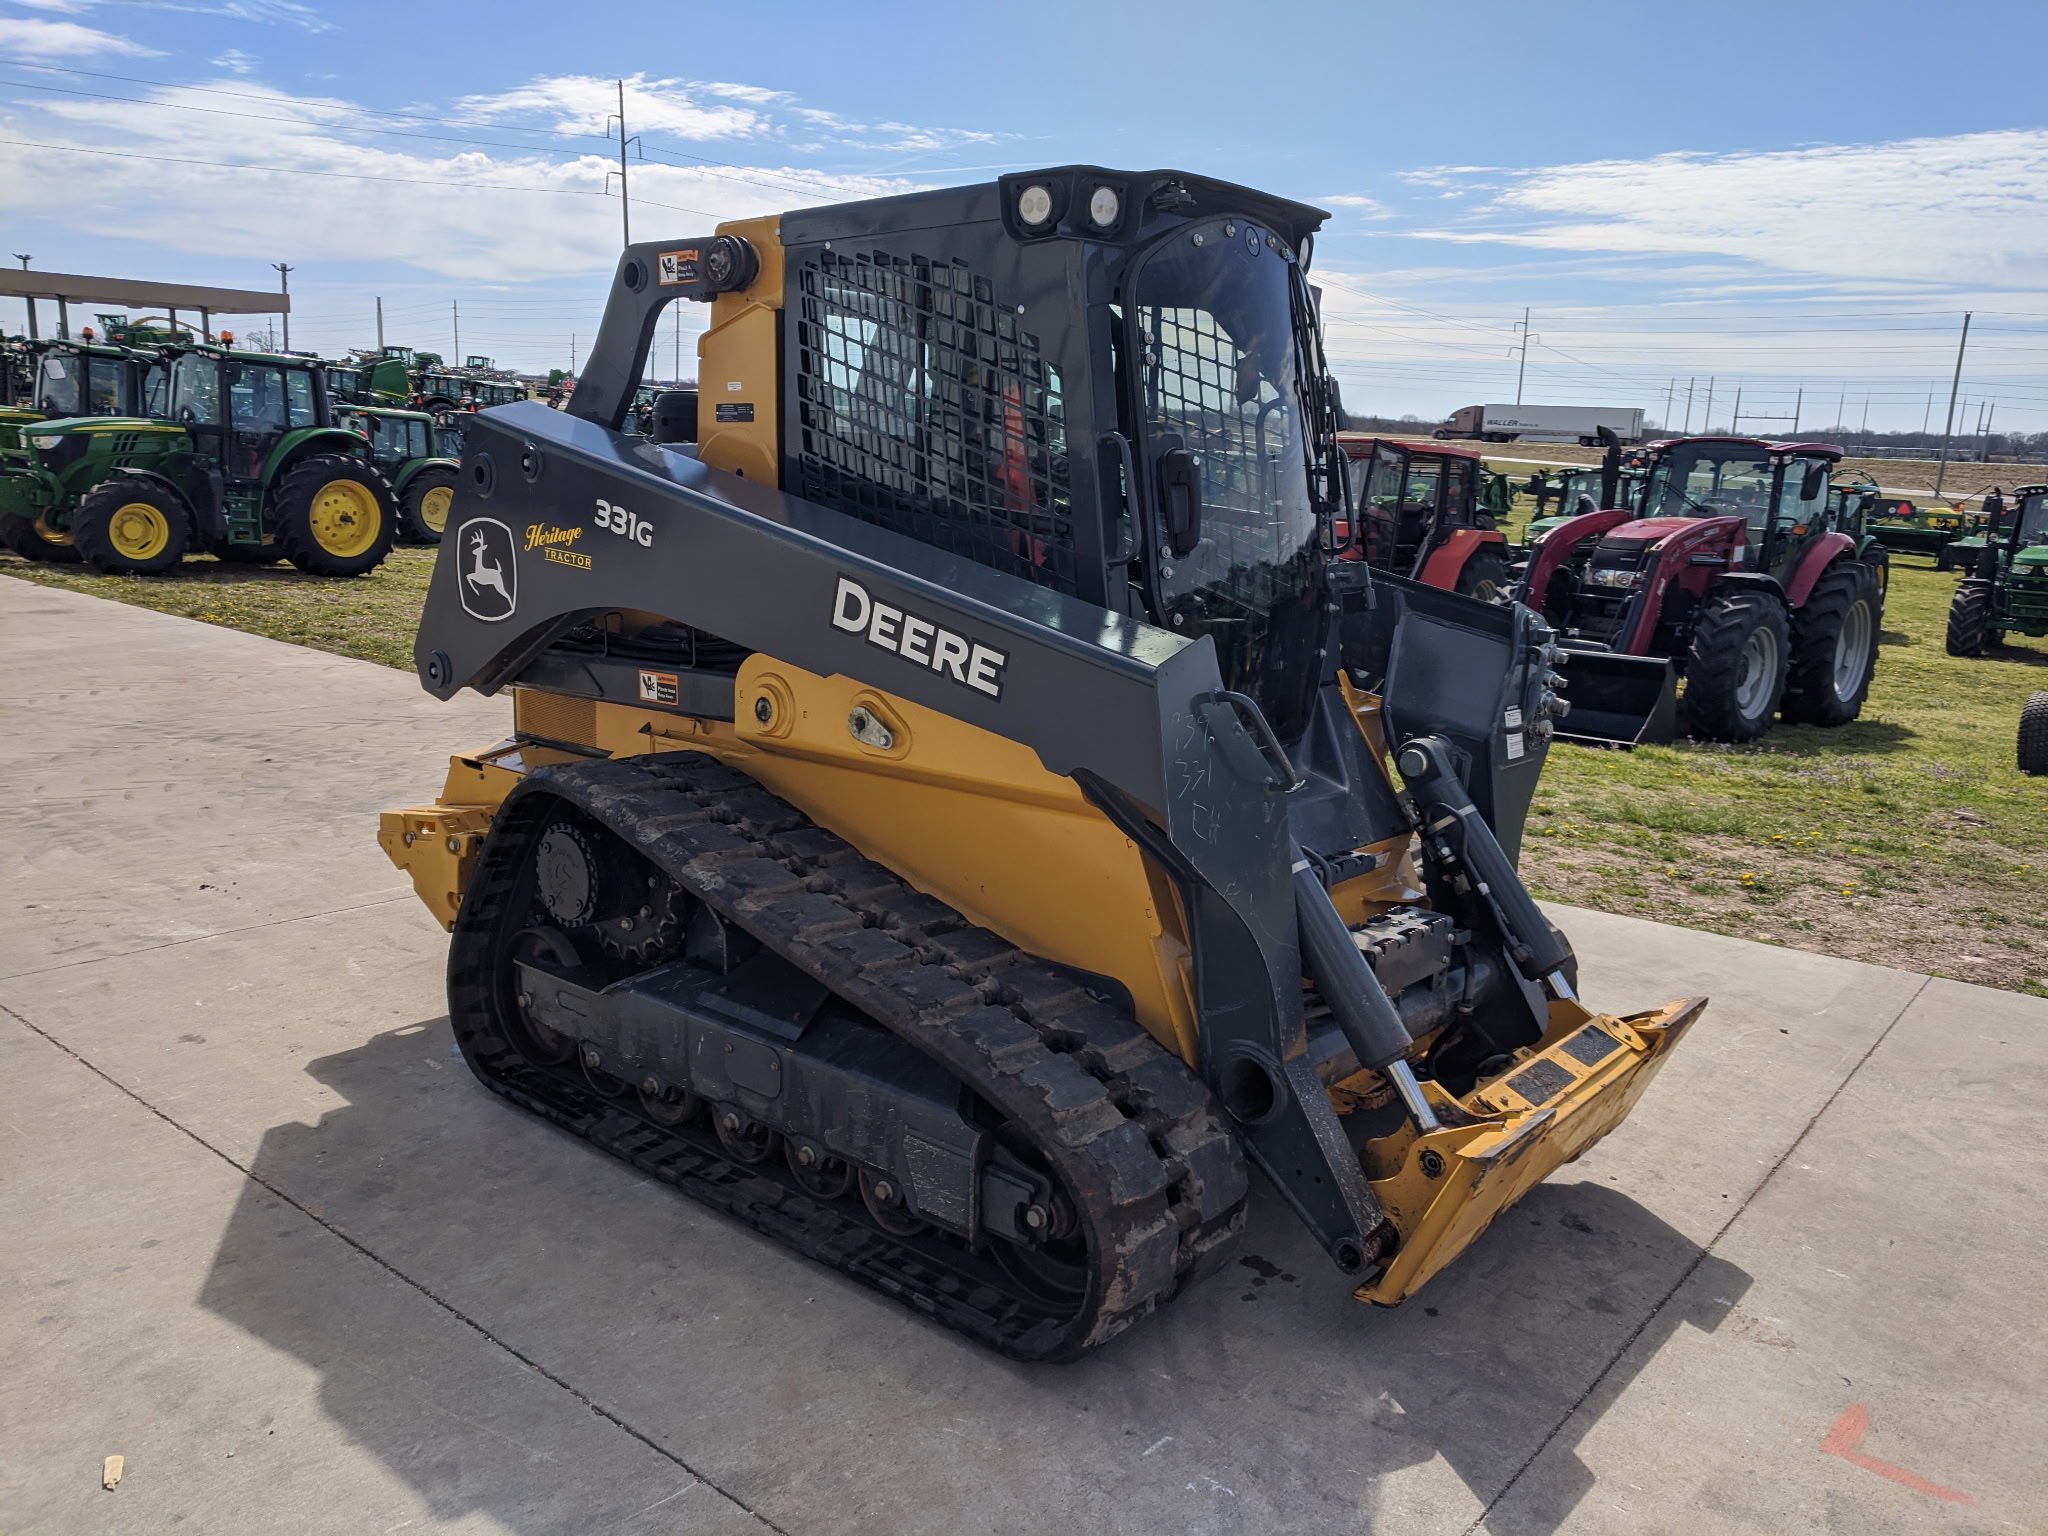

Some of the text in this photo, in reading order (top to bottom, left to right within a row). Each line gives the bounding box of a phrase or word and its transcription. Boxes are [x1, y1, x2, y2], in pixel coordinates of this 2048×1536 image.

[1486, 419, 1520, 428] WALLER
[524, 522, 582, 551] Heritage
[594, 499, 653, 548] 331G
[544, 548, 592, 568] TRACTOR
[832, 577, 1005, 697] DEERE
